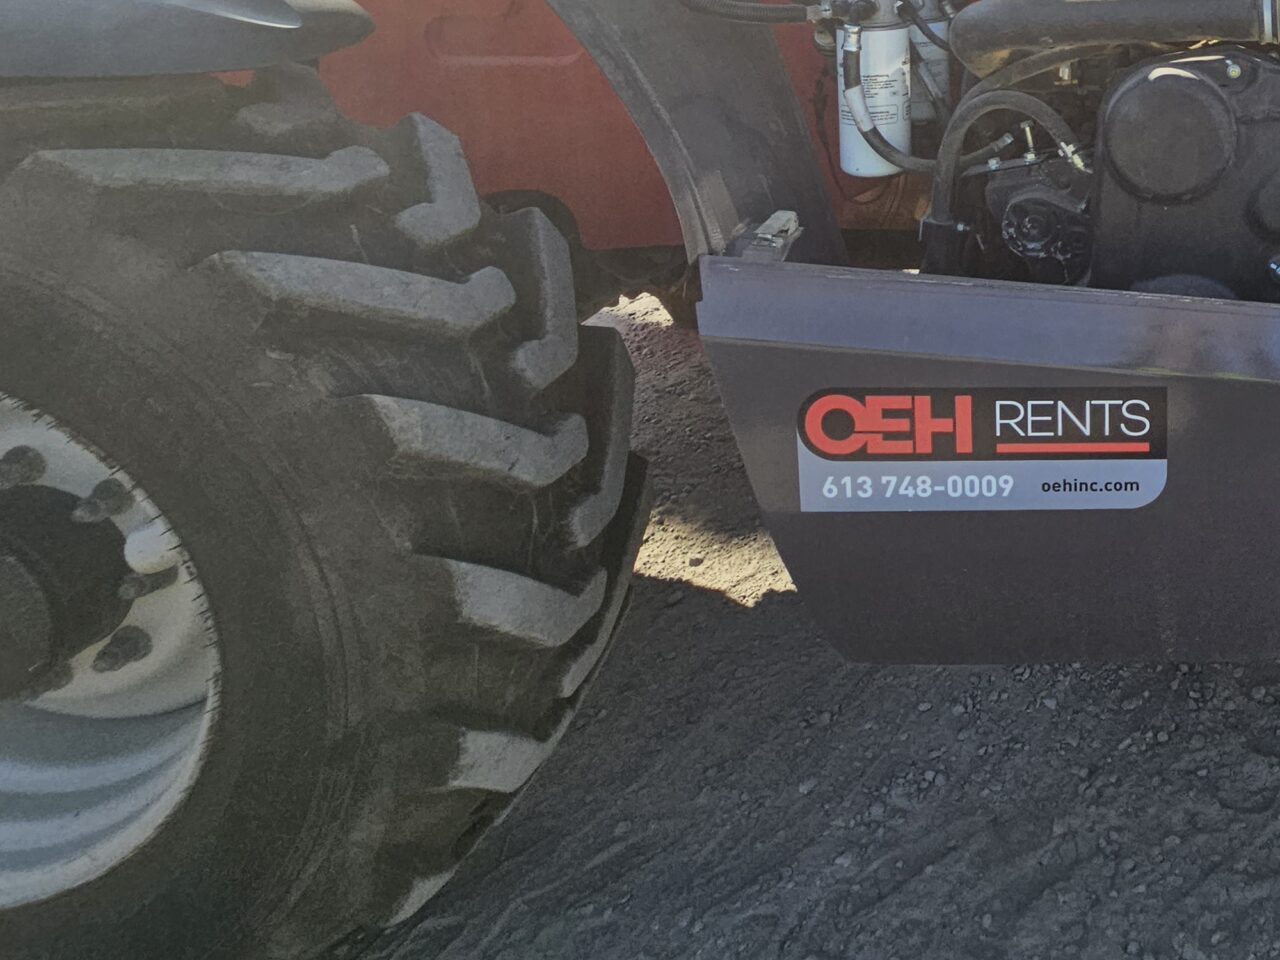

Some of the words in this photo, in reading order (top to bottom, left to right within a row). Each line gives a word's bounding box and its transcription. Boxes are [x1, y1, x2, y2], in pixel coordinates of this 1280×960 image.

[804, 394, 973, 455] OEH
[995, 399, 1151, 437] RENTS
[821, 475, 873, 499] 613
[881, 474, 1015, 498] 748-0009
[1040, 478, 1141, 493] oehinc.com
